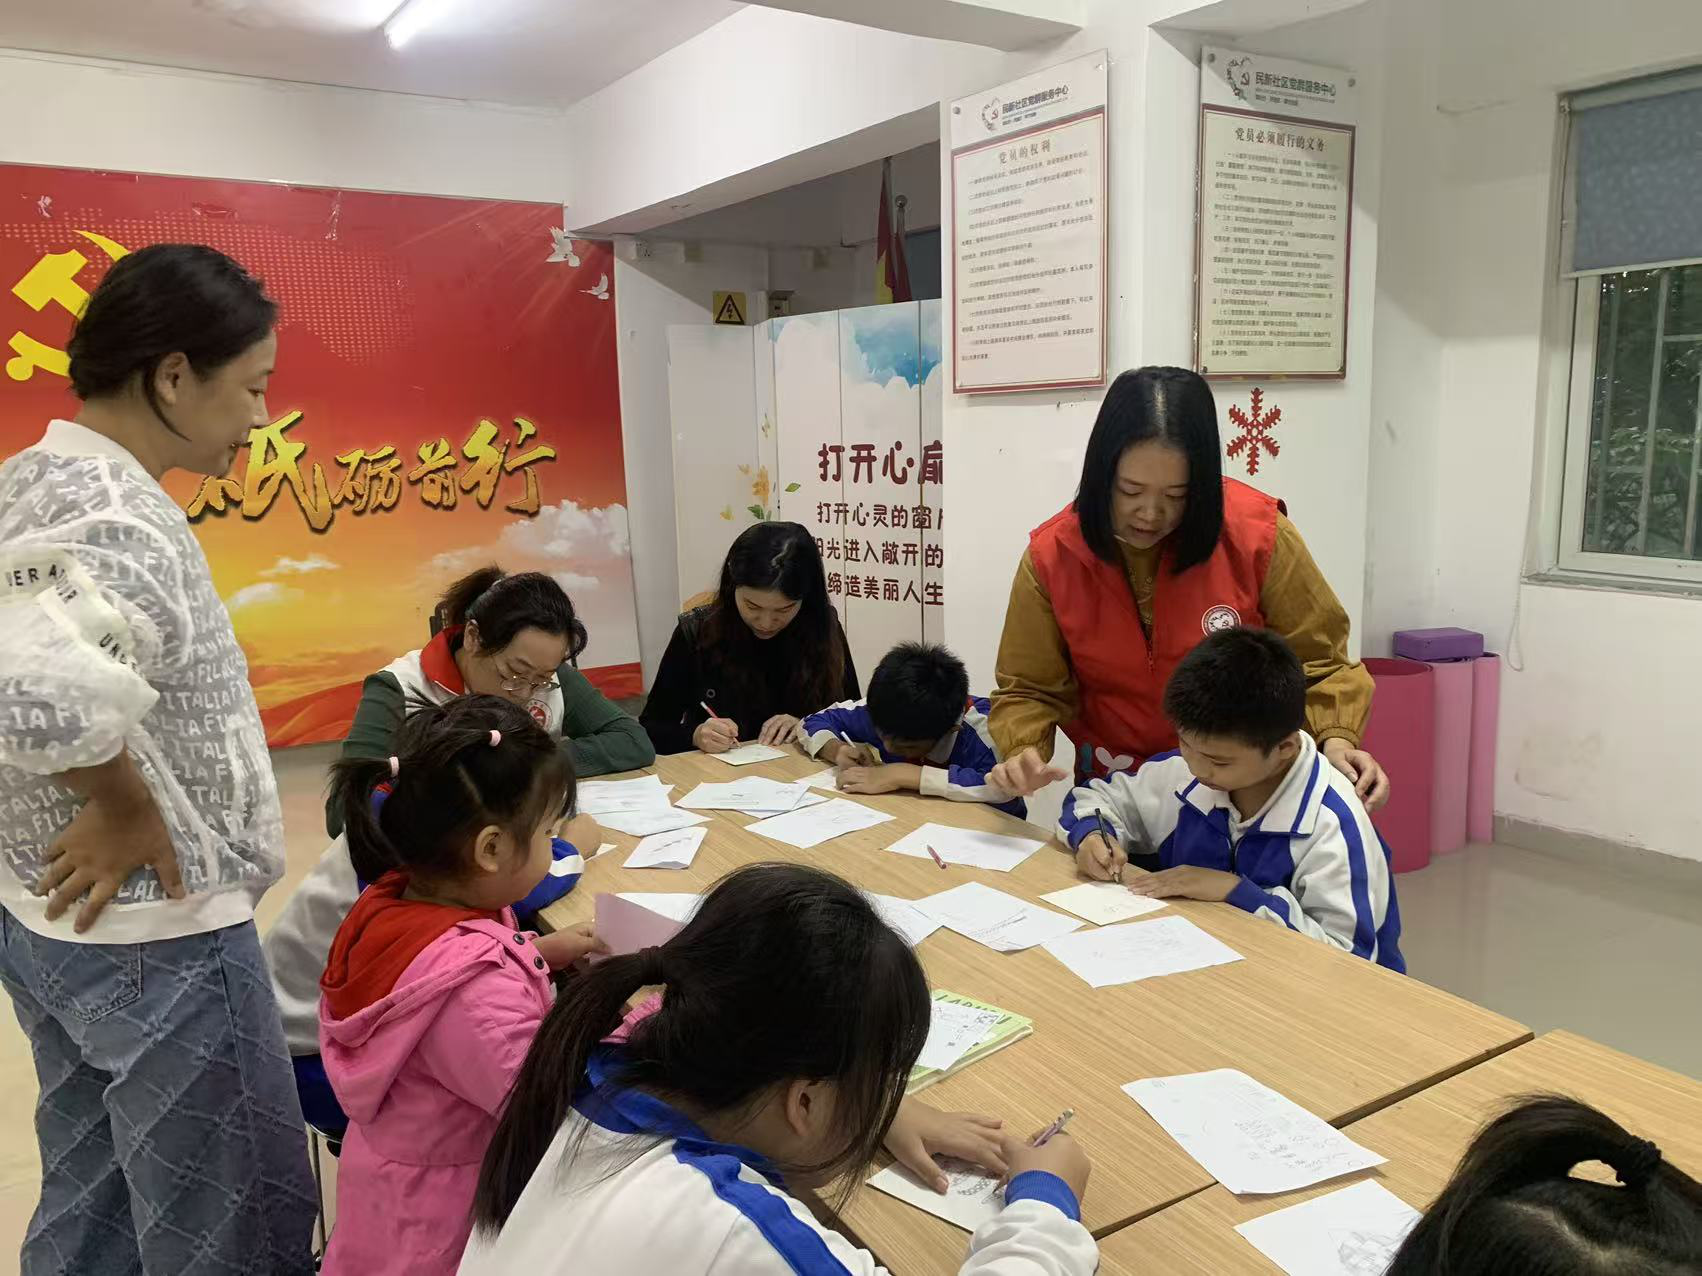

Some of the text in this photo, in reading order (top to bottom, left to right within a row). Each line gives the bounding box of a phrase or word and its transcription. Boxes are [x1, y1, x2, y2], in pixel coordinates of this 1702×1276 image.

[998, 138, 1052, 165] 党员的权利
[827, 572, 944, 606] 缔造美丽人生
